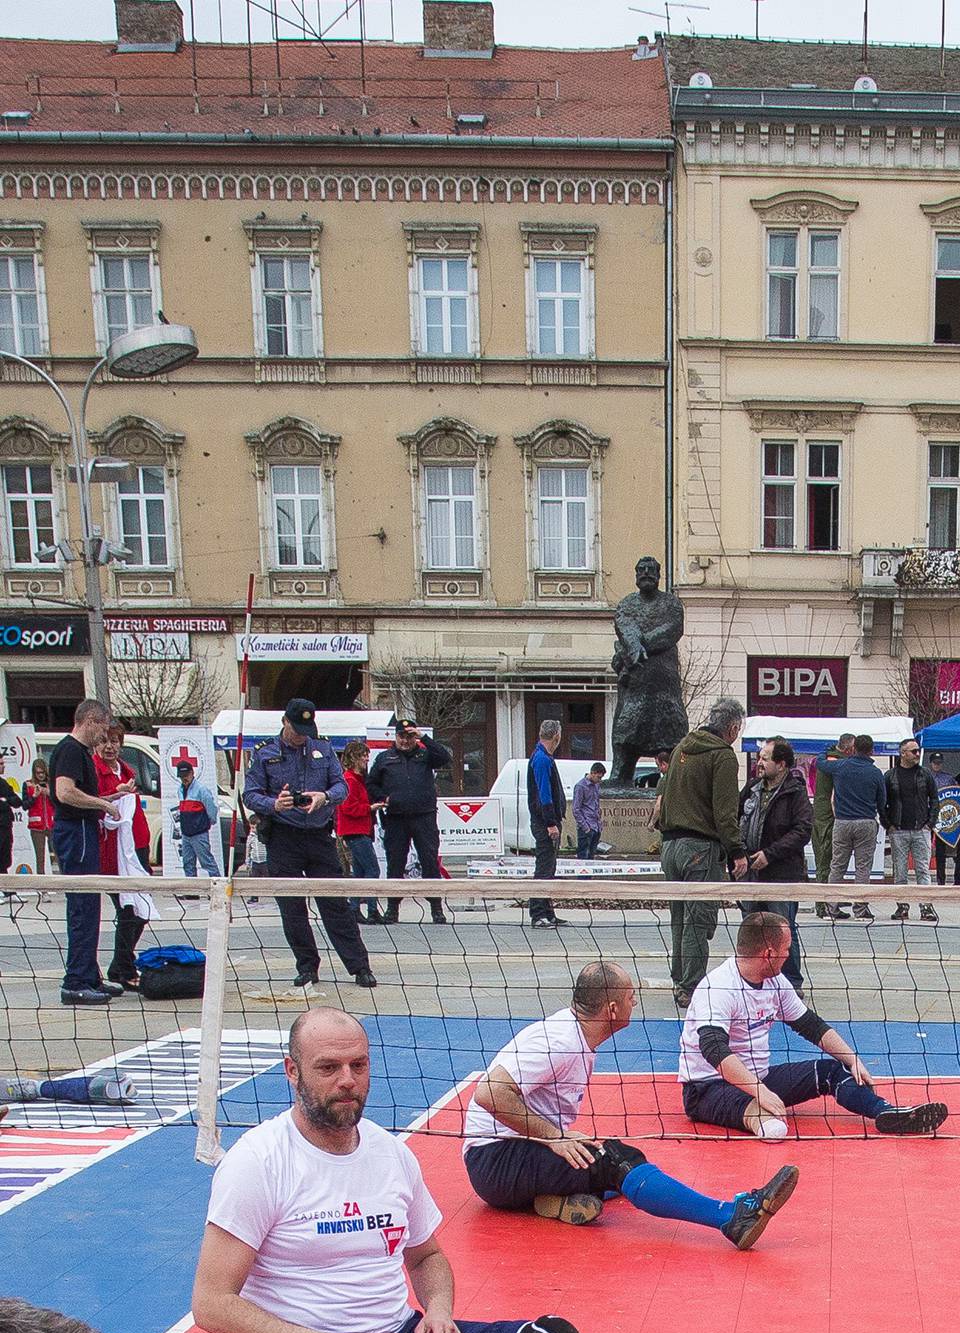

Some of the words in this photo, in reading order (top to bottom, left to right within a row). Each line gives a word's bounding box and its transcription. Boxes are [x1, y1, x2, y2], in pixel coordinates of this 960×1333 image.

[153, 619, 227, 631] SPAGHETERIA
[122, 634, 182, 659] LYRA
[240, 636, 299, 653] Kozmetički
[302, 638, 328, 651] salon
[758, 667, 838, 696] BIPA
[294, 1210, 341, 1221] ZAJEDNO
[343, 1202, 361, 1217] ZA
[317, 1218, 364, 1234] HRVATSKU
[366, 1213, 394, 1230] BEZ
